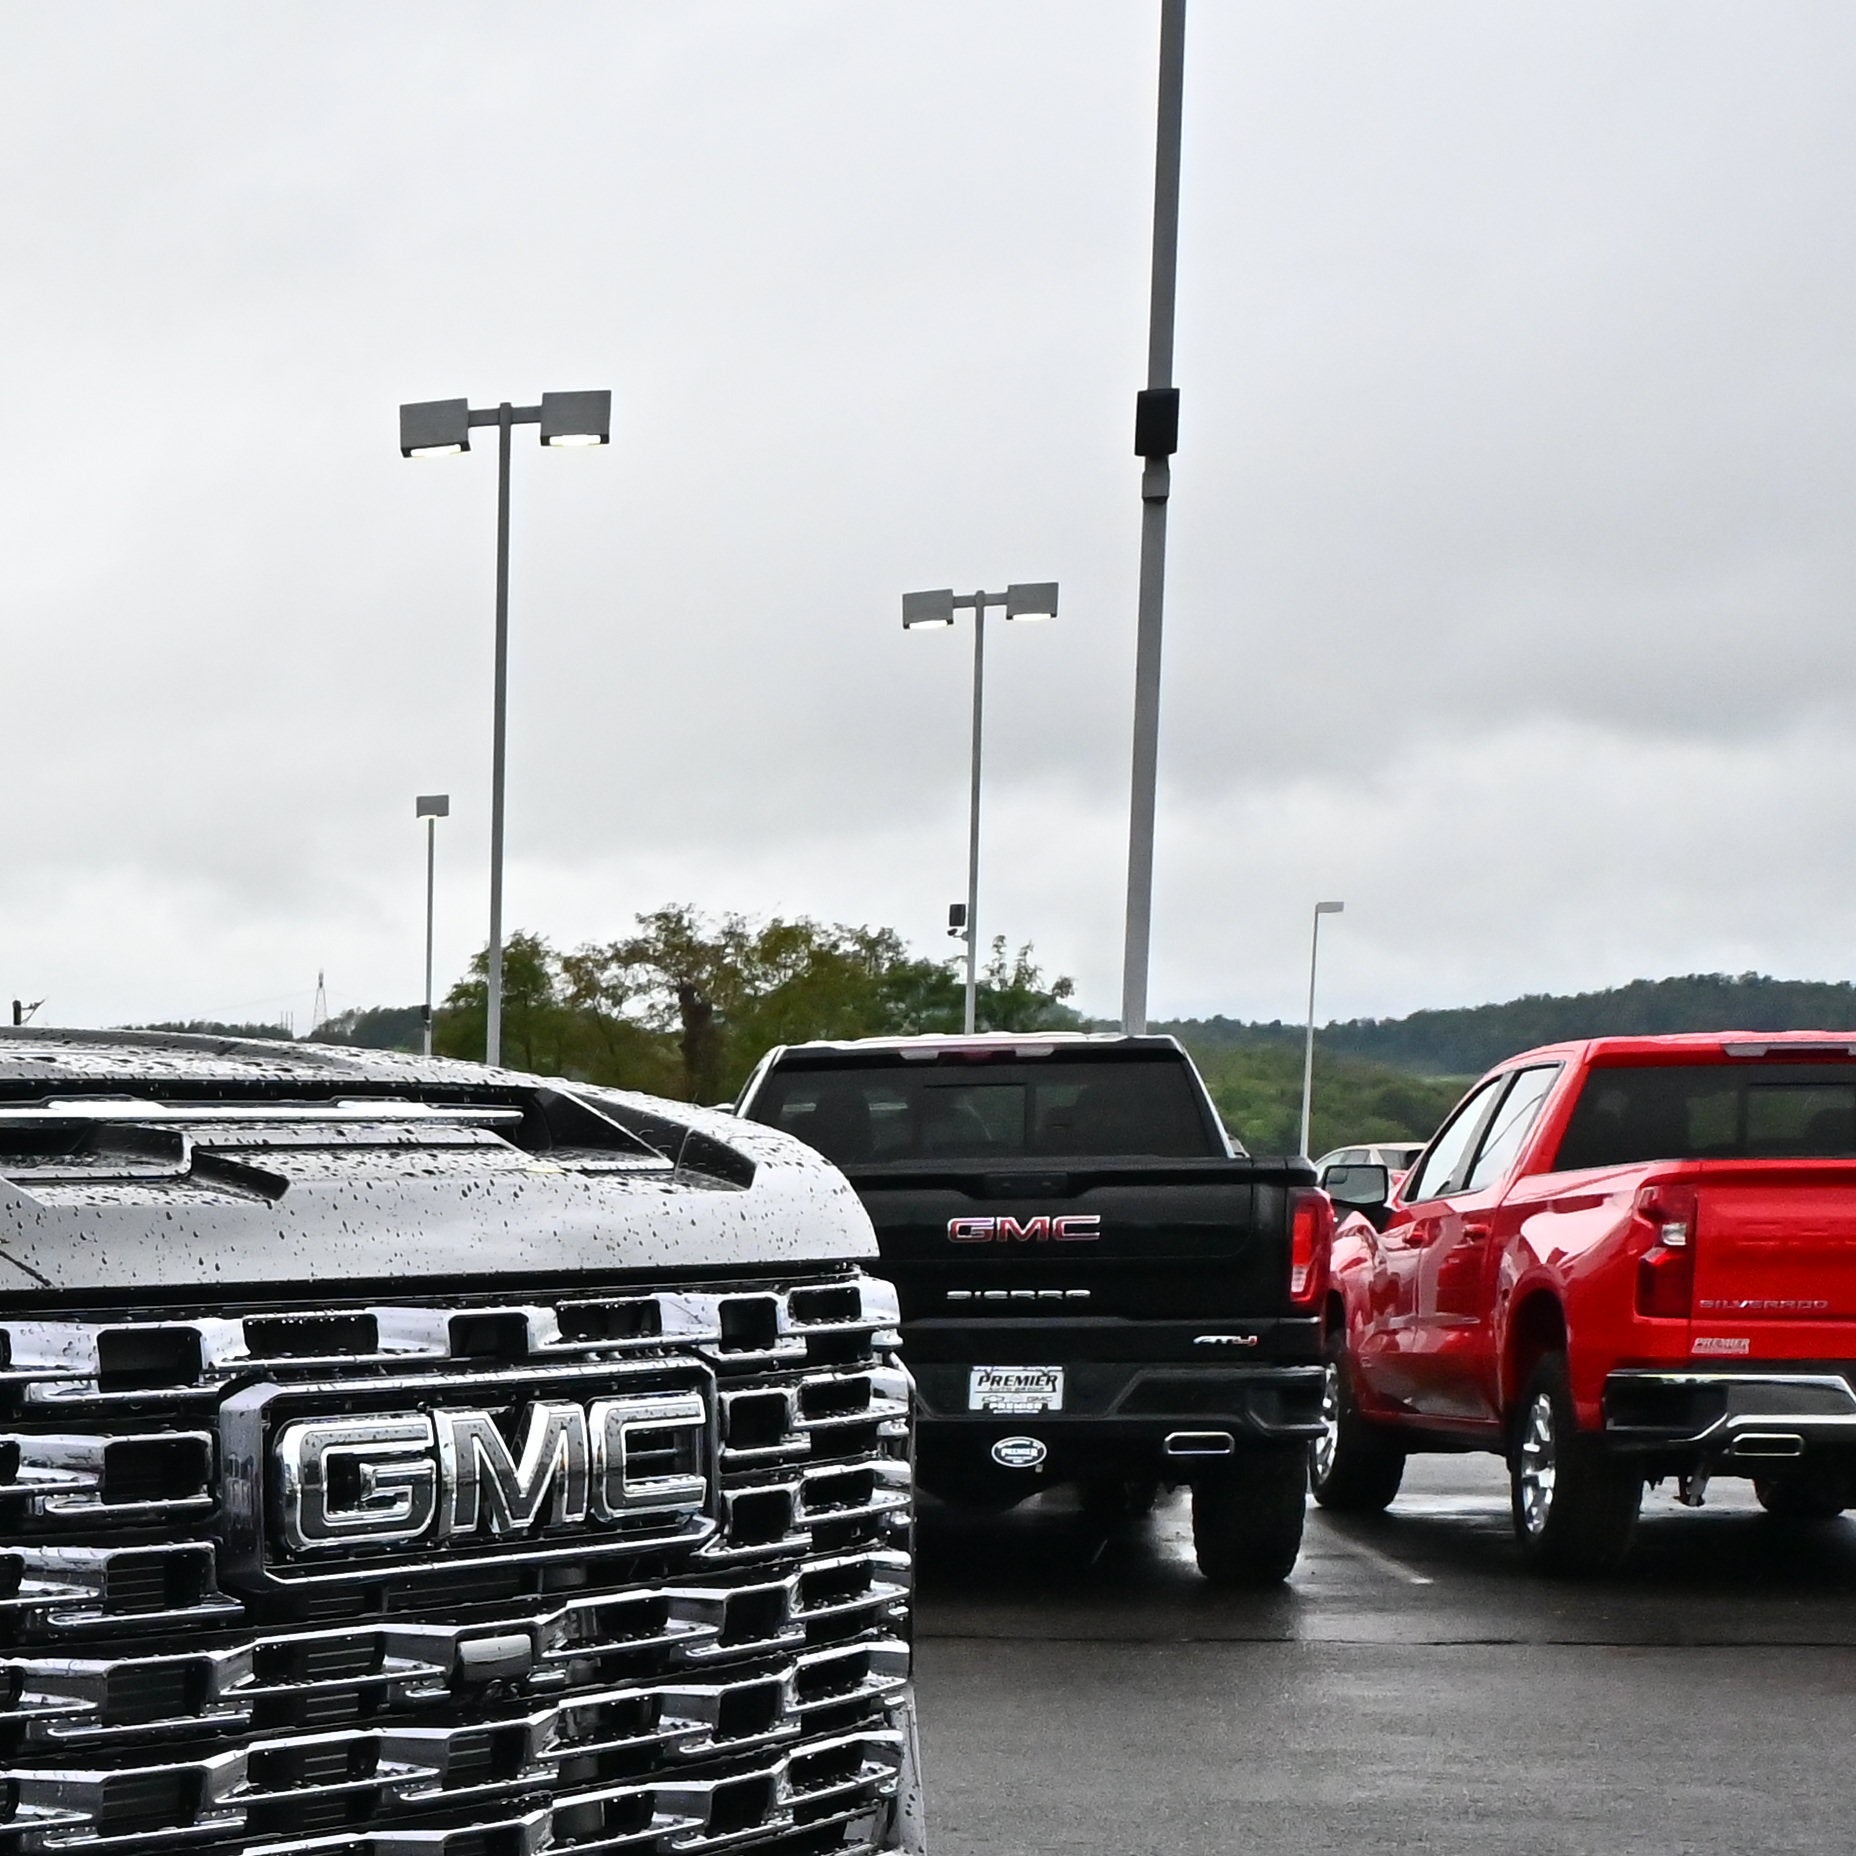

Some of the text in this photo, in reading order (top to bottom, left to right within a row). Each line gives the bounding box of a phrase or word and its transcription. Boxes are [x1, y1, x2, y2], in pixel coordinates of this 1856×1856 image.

[947, 1215, 1101, 1243] GMC
[946, 1289, 1092, 1300] SIERRA
[1699, 1299, 1829, 1310] SILVERADO
[977, 1374, 1059, 1393] PREMIER
[274, 1392, 707, 1550] GMC
